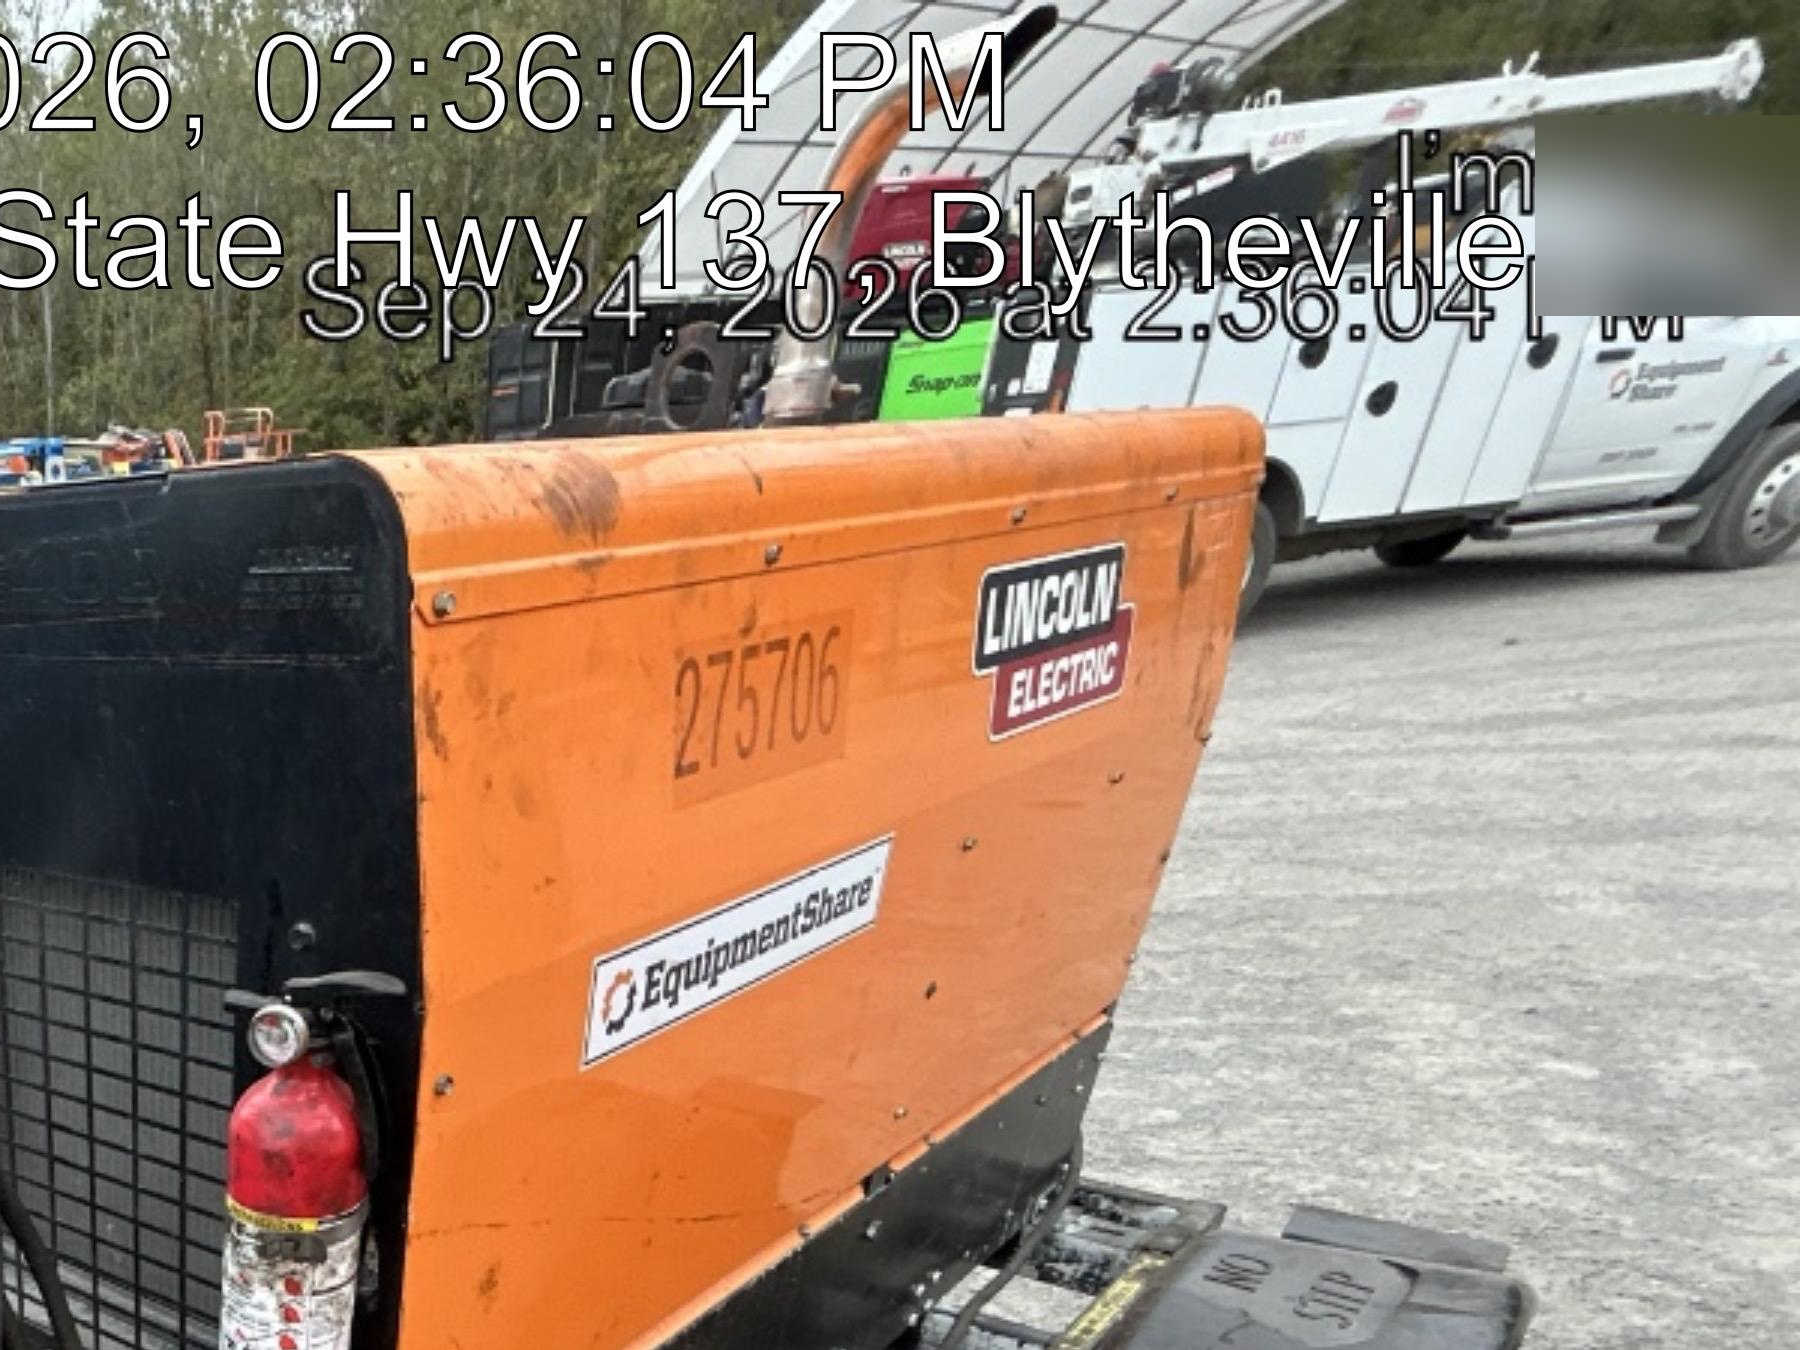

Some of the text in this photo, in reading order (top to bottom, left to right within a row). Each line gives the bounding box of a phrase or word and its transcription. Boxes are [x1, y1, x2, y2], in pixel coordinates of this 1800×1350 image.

[983, 561, 1119, 656] LINCOLN
[672, 625, 843, 781] 275706
[1006, 640, 1120, 719] ELECTRIC
[639, 874, 876, 1011] EquipmentShare
